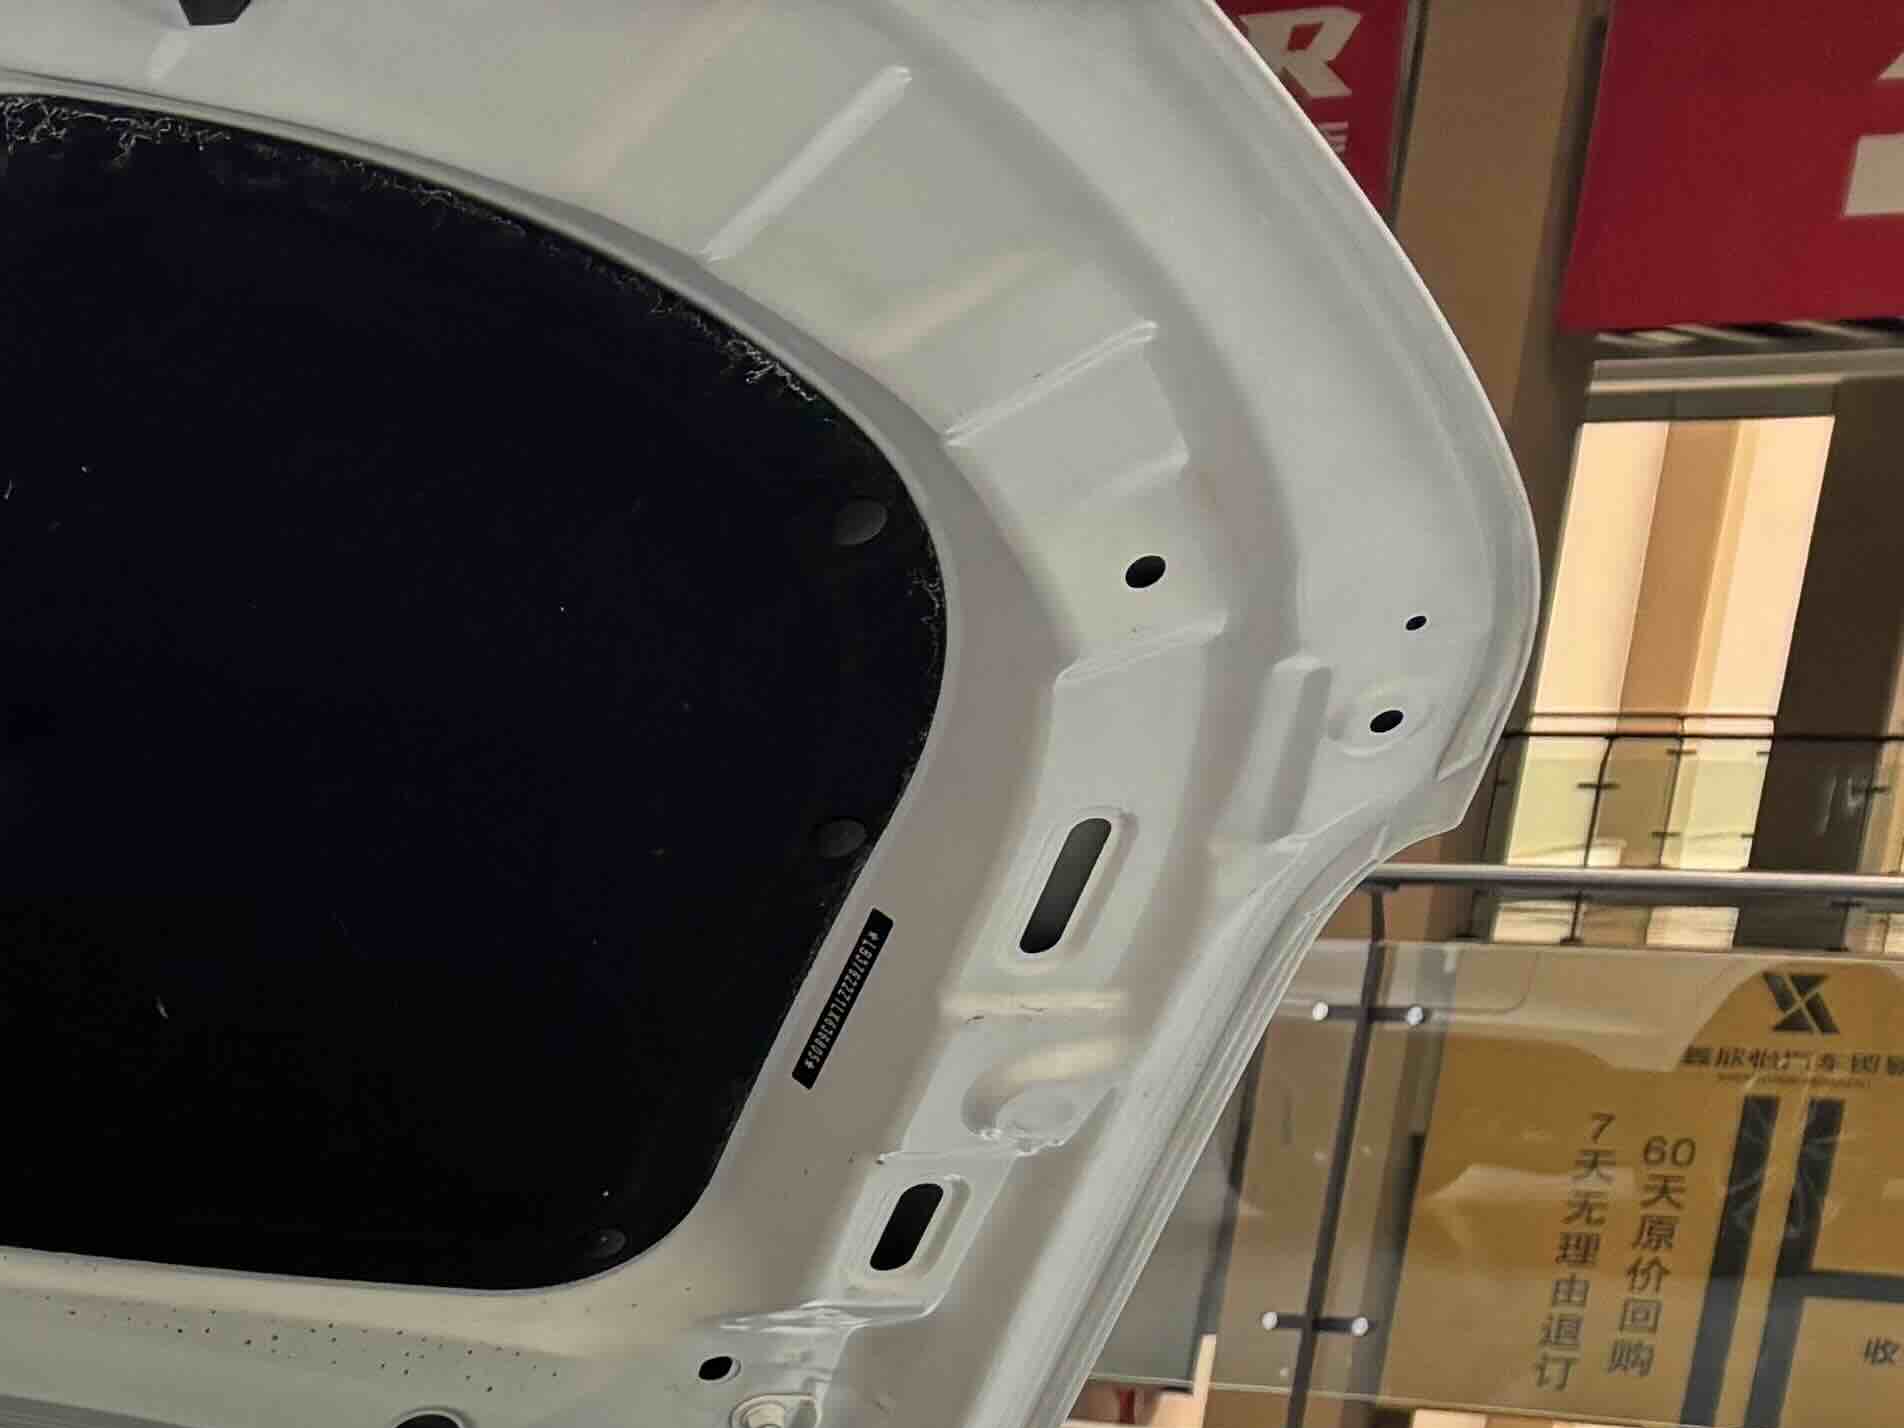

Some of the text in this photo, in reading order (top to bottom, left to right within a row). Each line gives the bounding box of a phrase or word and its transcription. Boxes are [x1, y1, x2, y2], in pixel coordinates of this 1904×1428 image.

[1607, 1135, 1697, 1378] 60天原价回购
